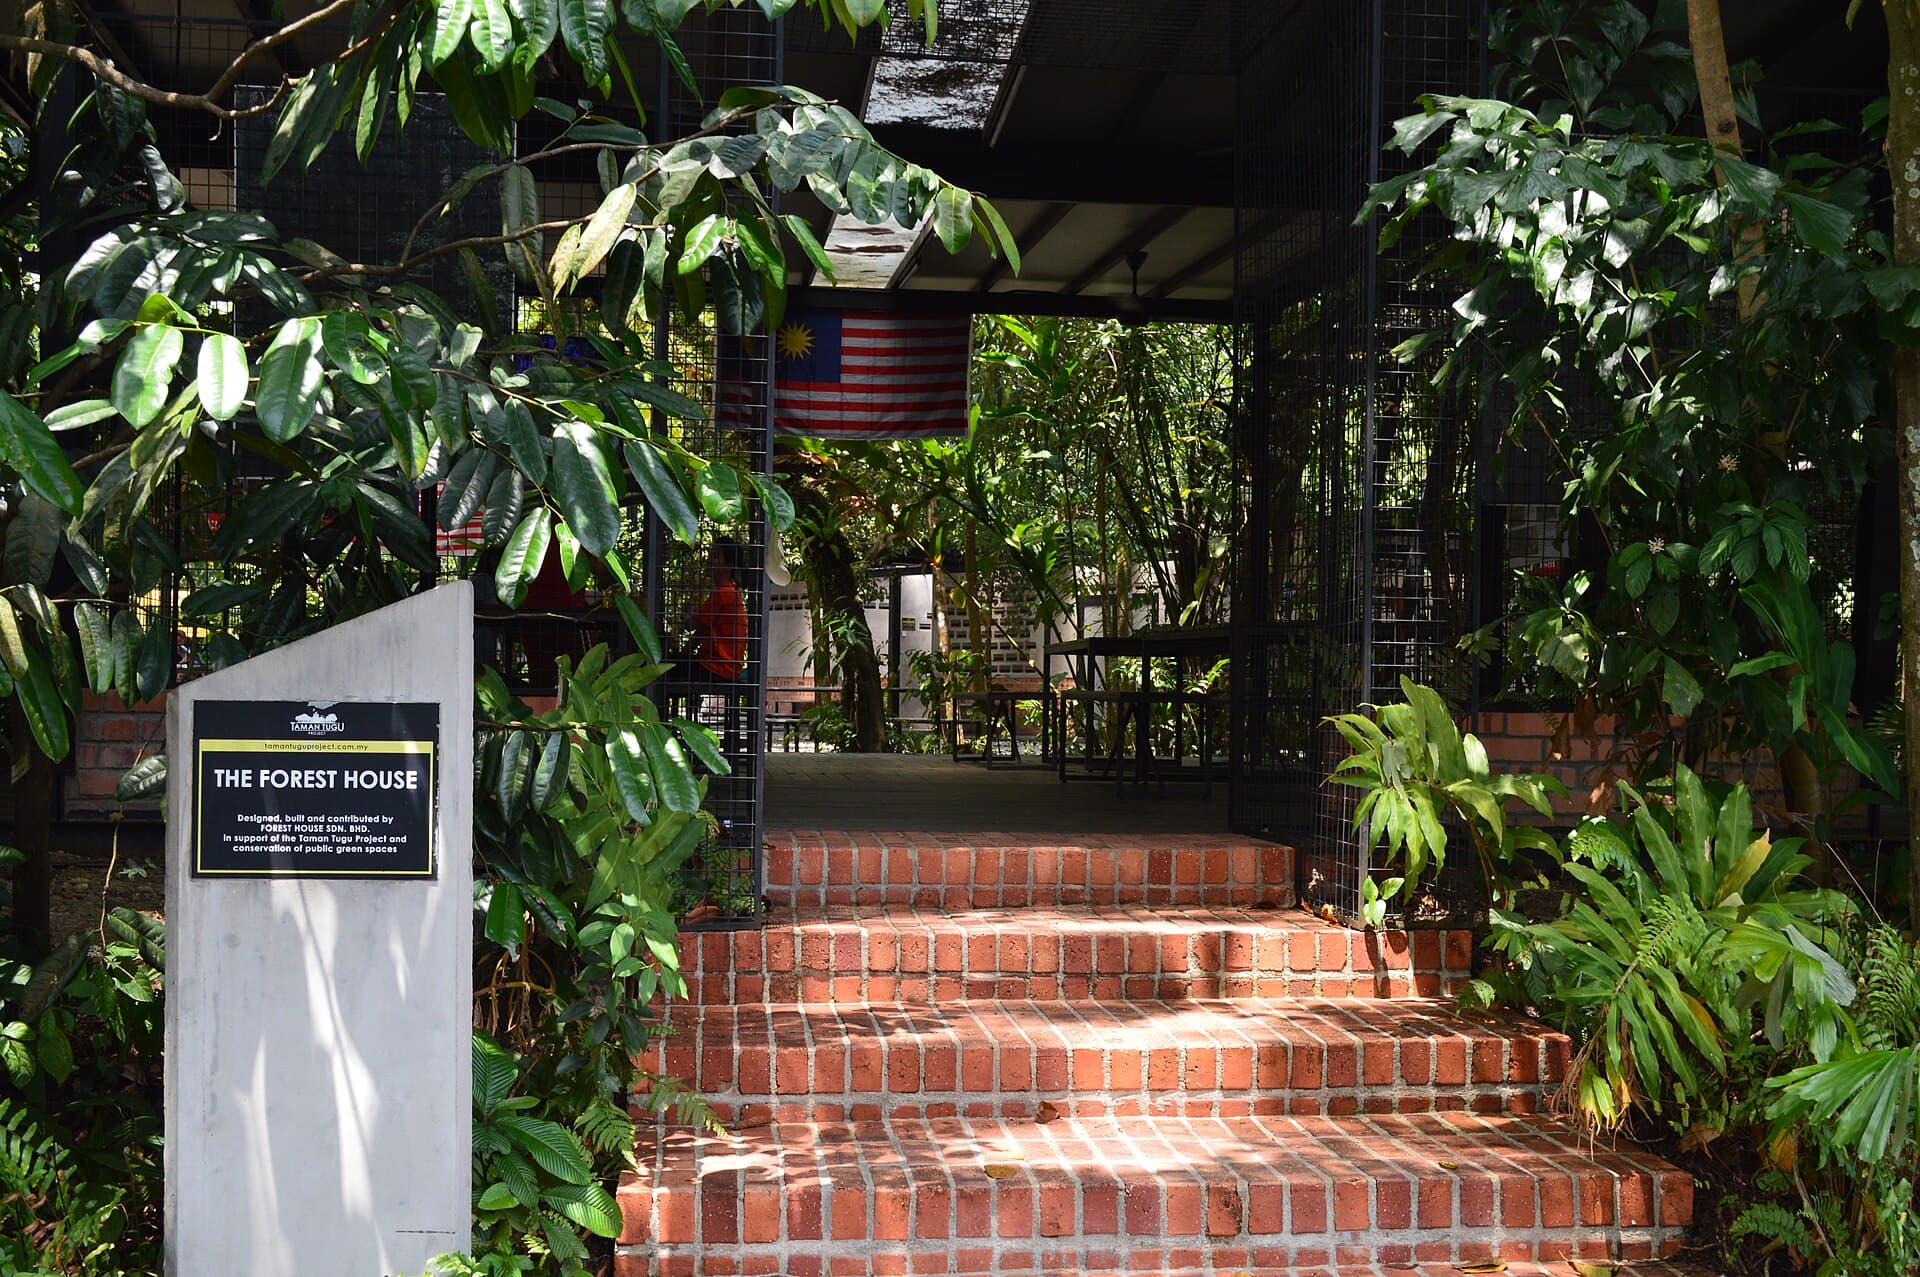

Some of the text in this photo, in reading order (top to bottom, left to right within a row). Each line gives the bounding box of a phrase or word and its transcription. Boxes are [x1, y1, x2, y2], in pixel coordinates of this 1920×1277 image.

[291, 721, 344, 732] TAMAN TUGU
[264, 742, 369, 751] tamantuguproject.com.my
[214, 769, 418, 790] THE FOREST HOUSE
[237, 814, 394, 824] Designed, built and contributed by
[260, 824, 370, 833] FOREST HOUSE SDN. BHD.
[234, 834, 268, 844] support
[270, 834, 280, 842] of
[281, 834, 297, 843] the
[299, 834, 329, 843] Taman
[331, 834, 353, 844] Tugu
[355, 834, 387, 844] Project
[389, 835, 407, 843] and
[232, 844, 398, 855] conservation of public green spaces
